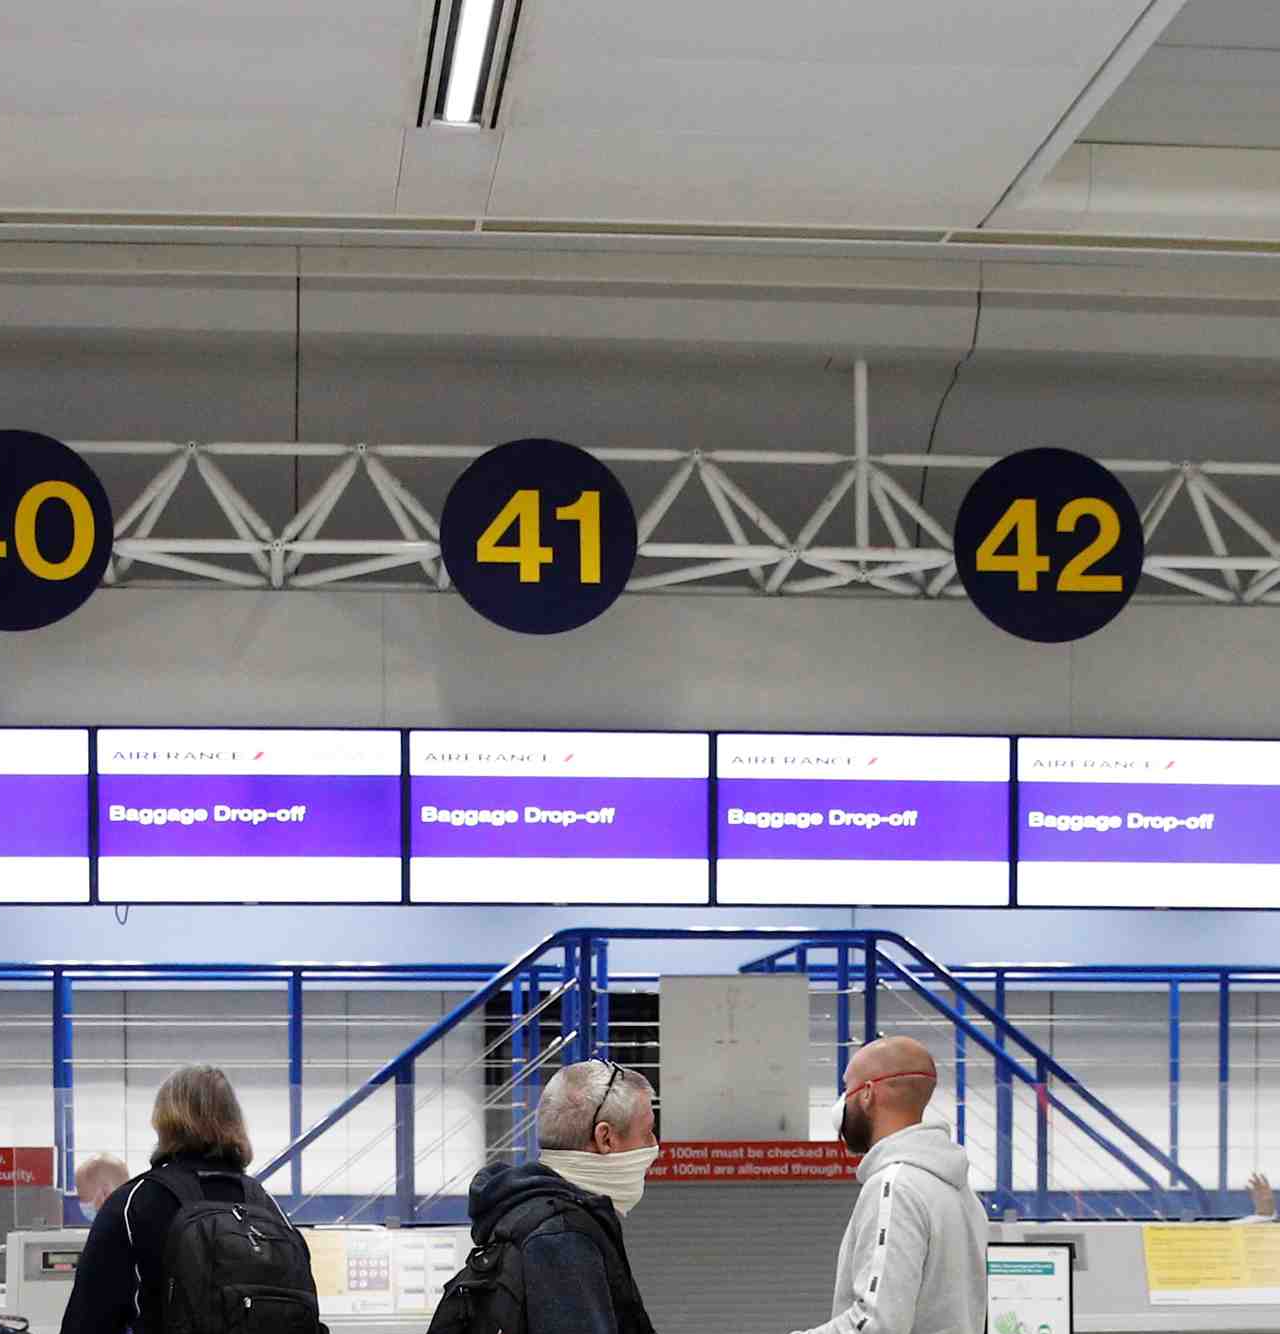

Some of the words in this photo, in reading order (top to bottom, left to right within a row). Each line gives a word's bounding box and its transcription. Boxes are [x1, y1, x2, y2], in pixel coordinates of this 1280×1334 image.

[477, 491, 600, 583] 41
[977, 499, 1122, 591] 42
[109, 805, 209, 825] Baggage
[214, 806, 306, 825] Drop-off
[421, 806, 518, 826] Baggage
[524, 807, 615, 827] Drop-off
[727, 808, 823, 829] Baggage
[828, 809, 918, 829] Drop-off
[1028, 811, 1122, 832] Baggage
[1127, 812, 1215, 832] Drop-off
[671, 1147, 708, 1158] 100ml
[711, 1147, 744, 1158] must
[748, 1148, 763, 1158] be
[767, 1147, 822, 1158] checked
[826, 1148, 838, 1158] in
[648, 1166, 667, 1175] ver
[672, 1164, 710, 1175] 100ml
[713, 1166, 736, 1175] are
[737, 1163, 789, 1175] allowed
[791, 1163, 842, 1177] through
